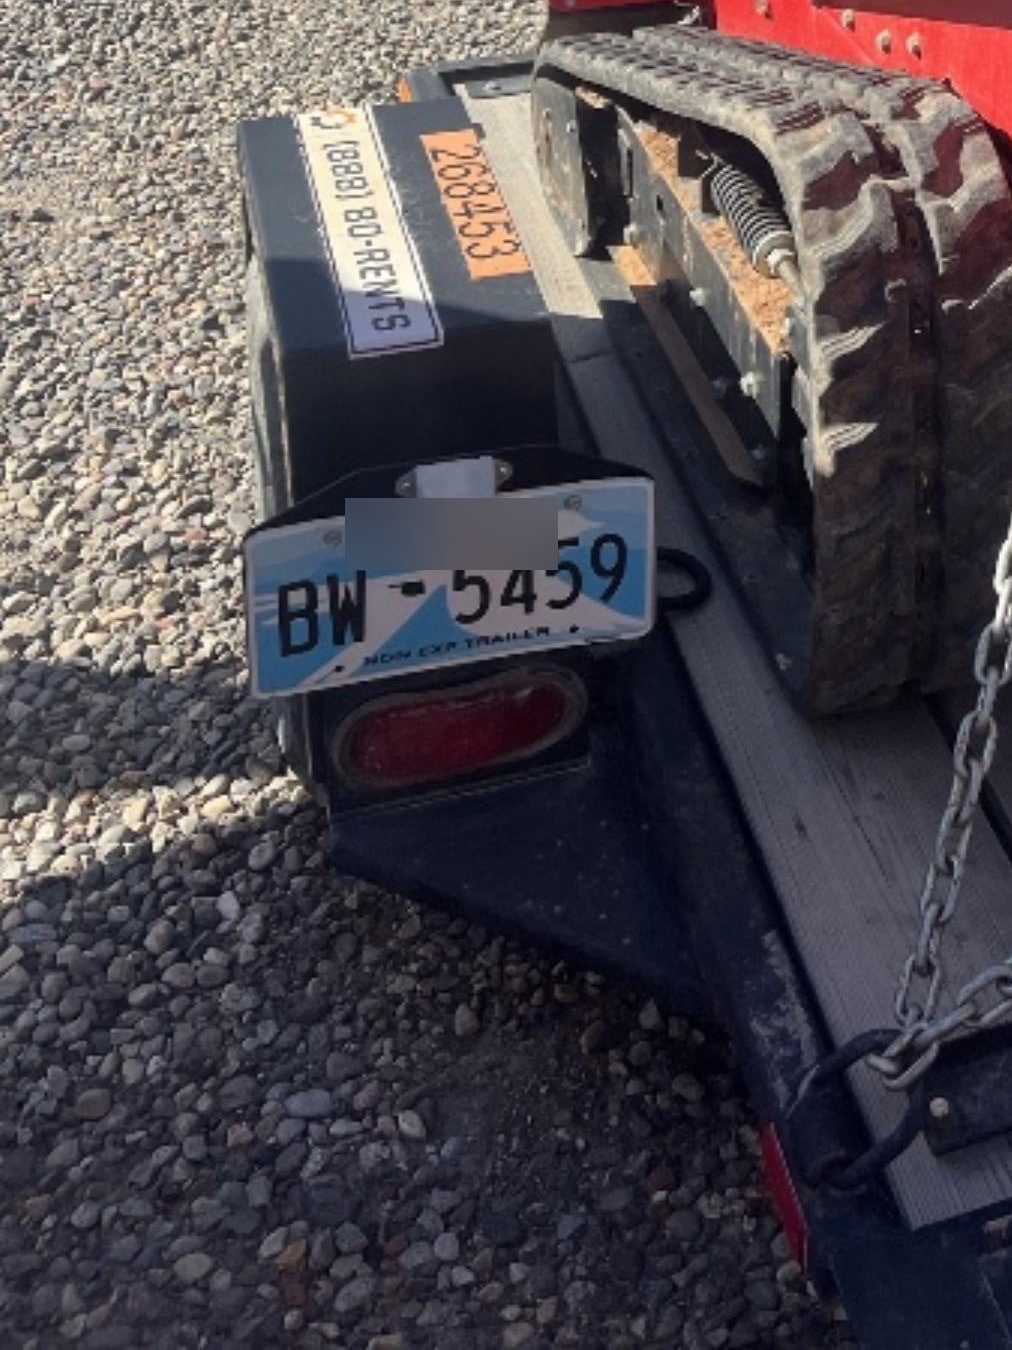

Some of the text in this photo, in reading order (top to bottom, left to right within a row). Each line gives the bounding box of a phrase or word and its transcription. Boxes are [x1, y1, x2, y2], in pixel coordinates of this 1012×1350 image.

[430, 143, 522, 260] 268453
[344, 205, 412, 331] 80-RENTS
[278, 569, 368, 657] BW
[464, 626, 550, 650] TRAILER
